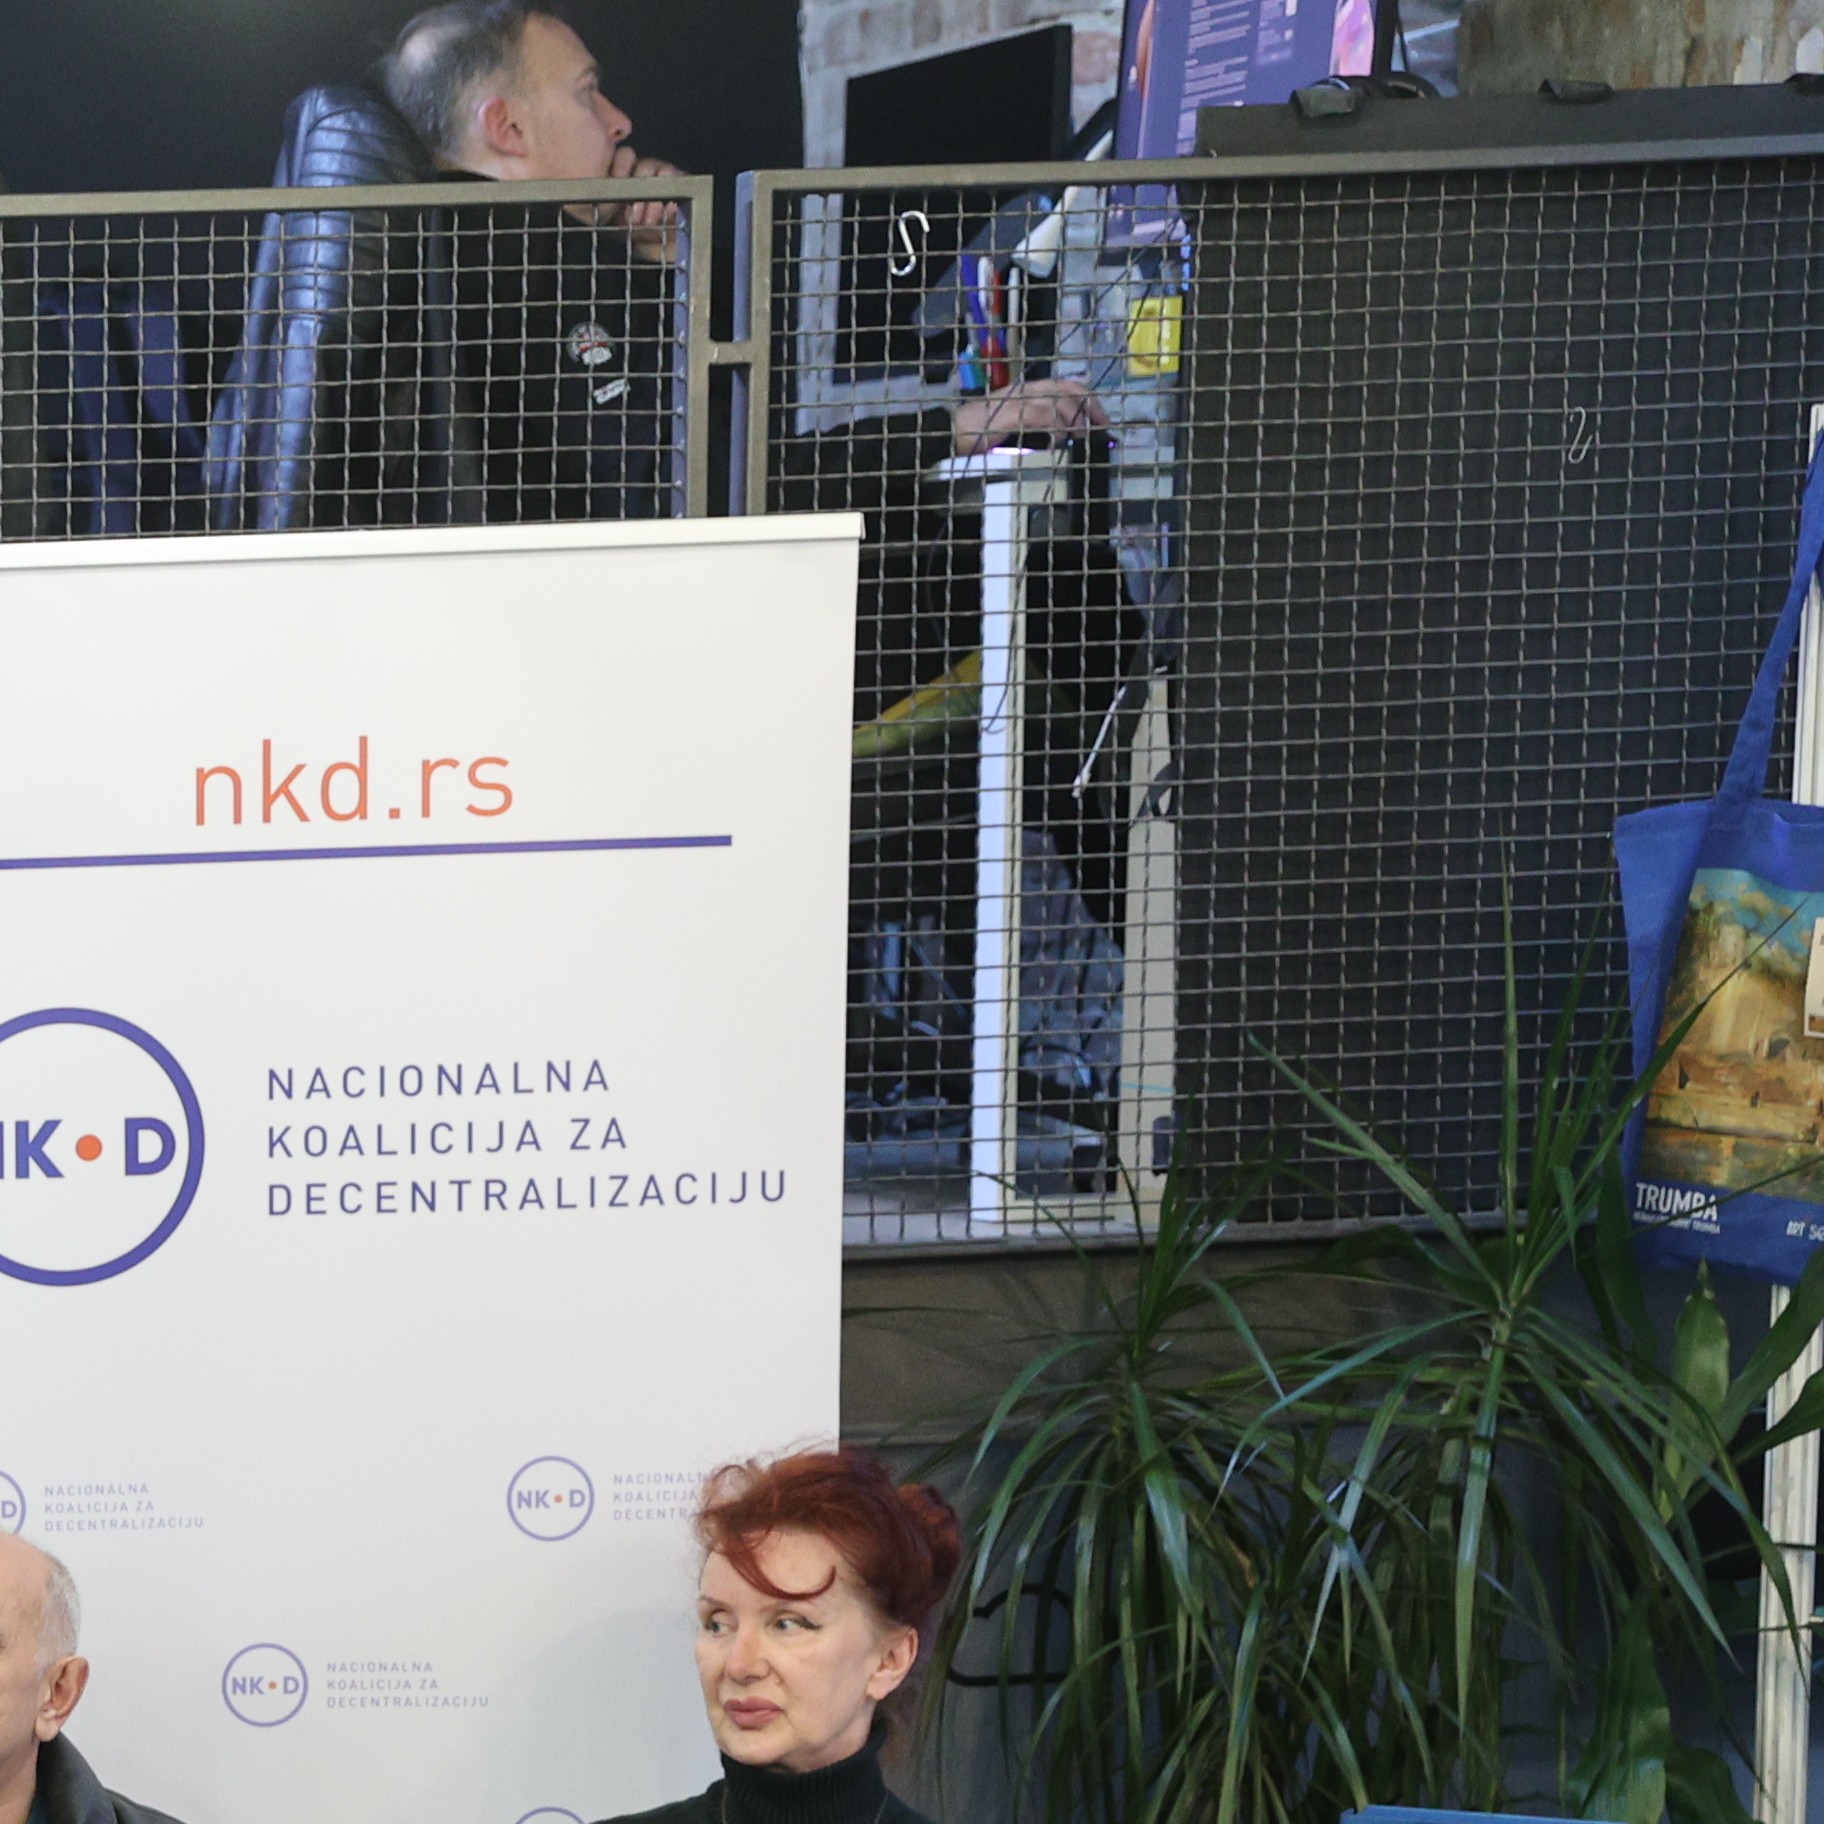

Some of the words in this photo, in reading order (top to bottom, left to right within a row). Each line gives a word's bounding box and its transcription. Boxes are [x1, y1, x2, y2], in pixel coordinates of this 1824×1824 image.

[194, 735, 515, 826] nkd.rs
[267, 1059, 610, 1101] NACIONALNA
[267, 1119, 543, 1159] KOALICIJA
[569, 1117, 629, 1152] ZA
[267, 1170, 787, 1217] DECENTRALIZACIJU
[1635, 1182, 1718, 1222] TRUMBA
[44, 1483, 149, 1497] NACIONALNA
[44, 1501, 129, 1514] KOALICIJA
[135, 1500, 155, 1512] ZA
[44, 1516, 204, 1532] DECENTRALIZACIJU
[326, 1661, 433, 1674] NACIONALNA
[326, 1678, 412, 1690] KOALICIJA
[419, 1678, 439, 1690] ZA
[326, 1696, 490, 1709] DECENTRALIZACIJU
